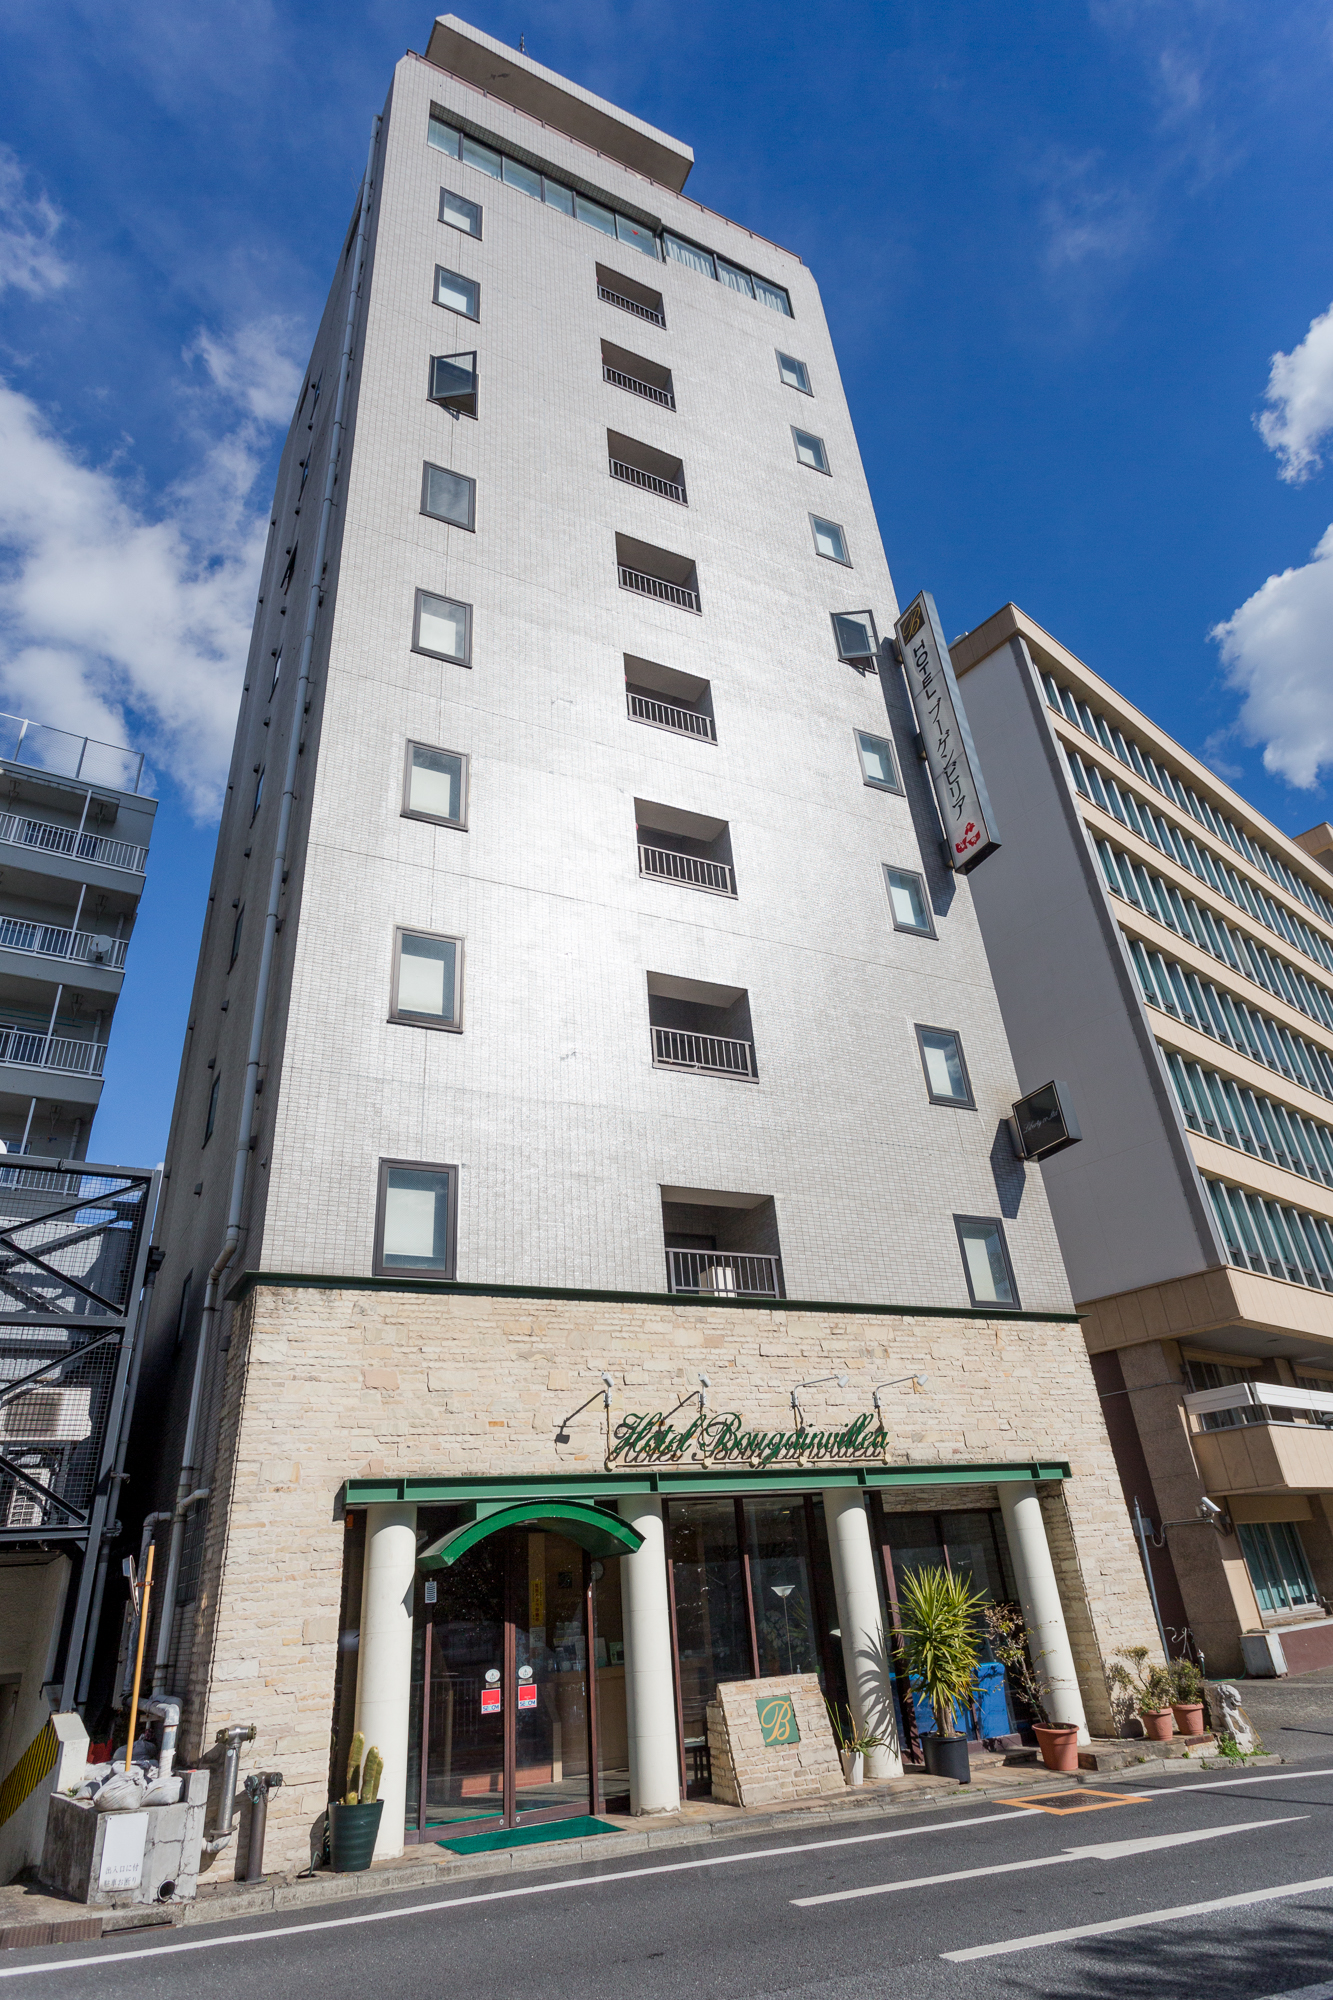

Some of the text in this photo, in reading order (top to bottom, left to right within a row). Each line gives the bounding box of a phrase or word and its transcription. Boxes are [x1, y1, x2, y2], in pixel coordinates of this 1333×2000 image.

[913, 638, 937, 700] HOTEL
[928, 696, 966, 821] ブーゲンビリア
[614, 1411, 890, 1464] Hotel Bougainvillea
[761, 1700, 791, 1743] B
